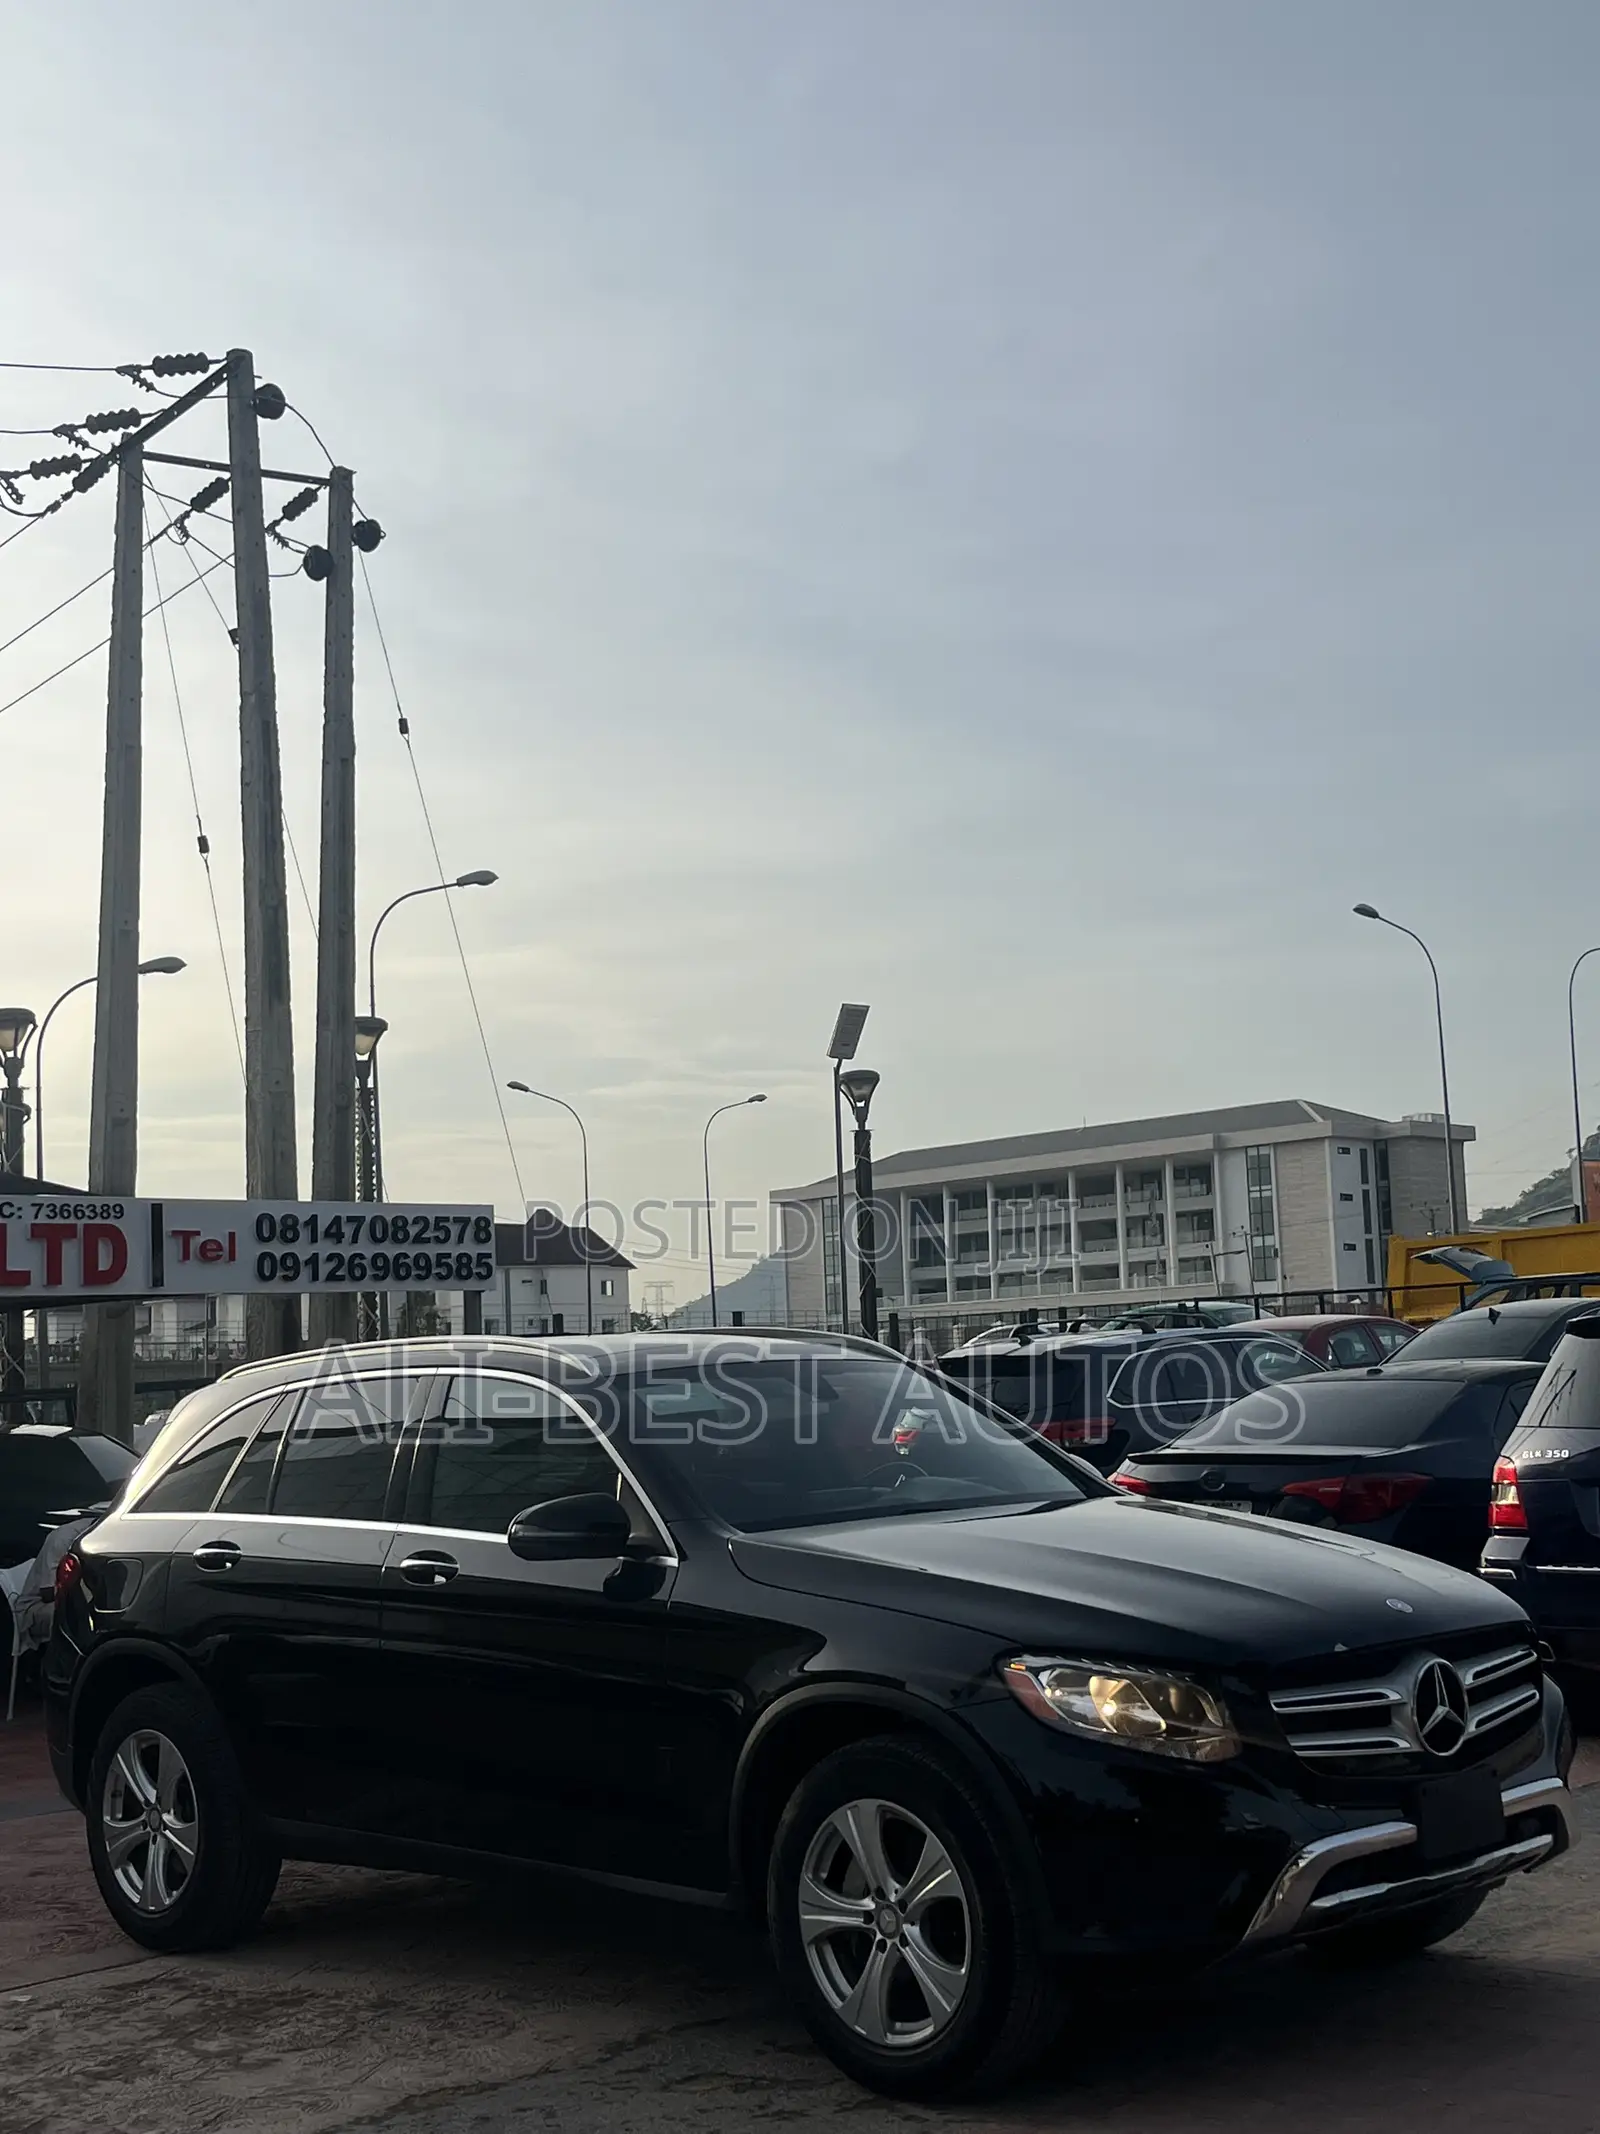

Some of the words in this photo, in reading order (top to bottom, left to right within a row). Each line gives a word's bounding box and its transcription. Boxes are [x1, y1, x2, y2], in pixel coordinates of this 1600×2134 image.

[30, 1203, 125, 1220] 7366389
[255, 1212, 493, 1245] 08147082578
[0, 1223, 128, 1287] LTD
[171, 1229, 236, 1263] Tel
[256, 1251, 494, 1283] 09126969585
[1544, 1449, 1570, 1459] 350
